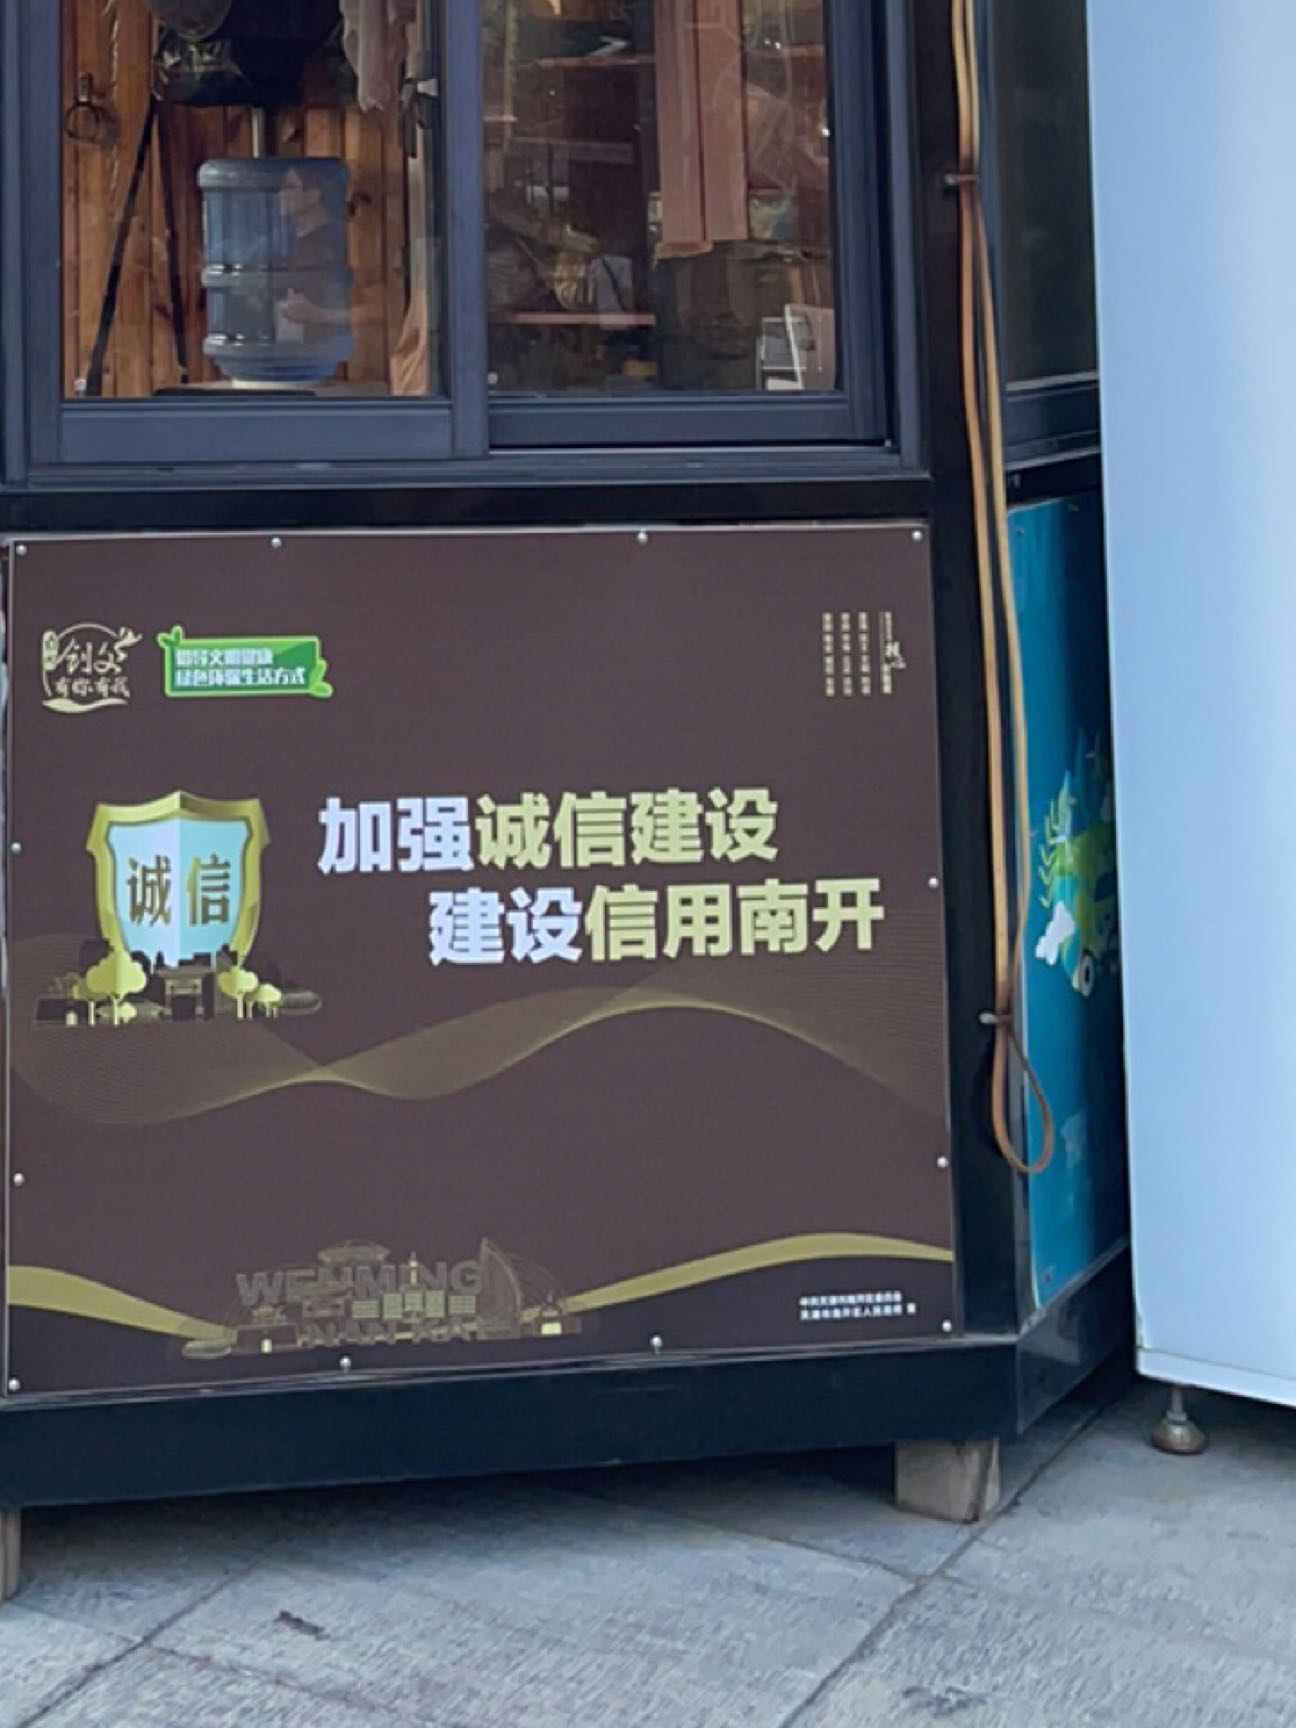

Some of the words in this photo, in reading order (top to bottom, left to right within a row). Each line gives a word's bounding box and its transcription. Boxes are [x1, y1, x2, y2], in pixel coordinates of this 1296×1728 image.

[317, 786, 780, 876] 加强诚信建设
[125, 853, 233, 929] 诚信
[427, 877, 886, 966] 建设信用南开
